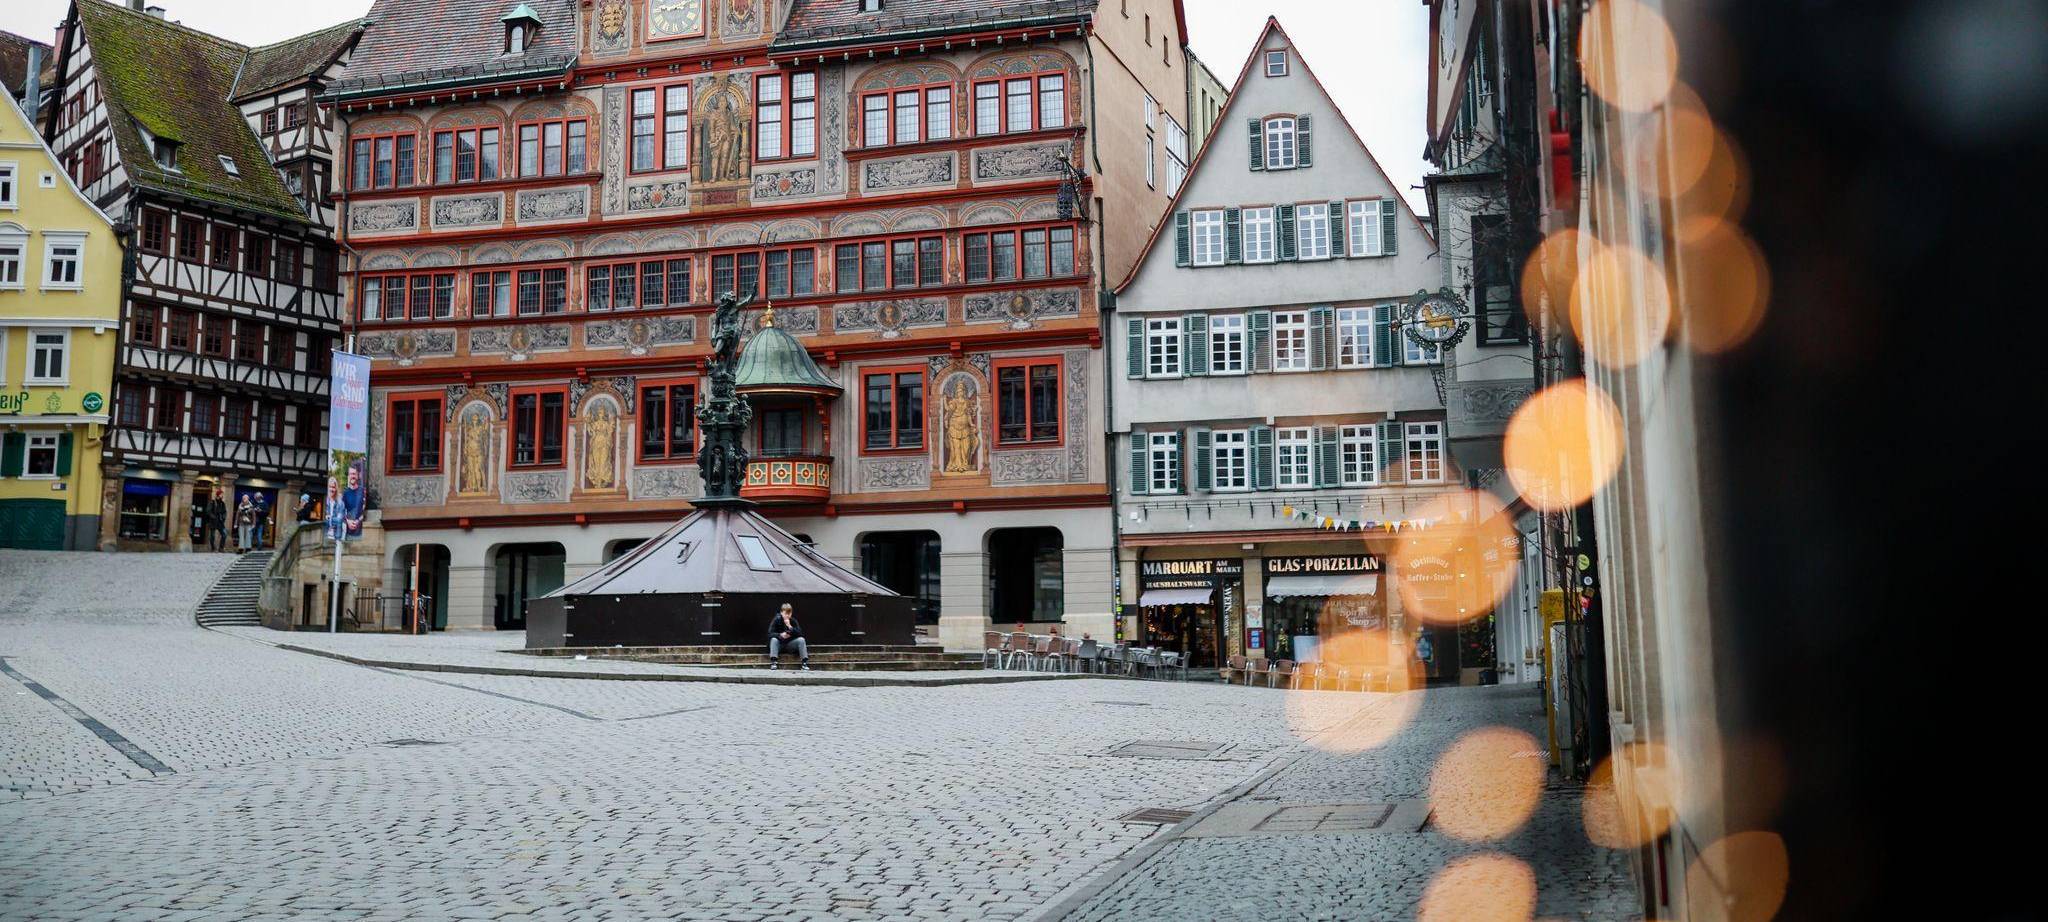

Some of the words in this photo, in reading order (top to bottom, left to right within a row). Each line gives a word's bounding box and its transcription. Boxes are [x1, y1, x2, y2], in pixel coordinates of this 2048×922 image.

[335, 359, 357, 381] WIR
[341, 383, 365, 403] SIND
[1143, 561, 1213, 575] MARQUART
[1268, 557, 1379, 572] GLAS-PORZELLAN
[1146, 580, 1213, 589] HAUSHALTSWAREN
[1223, 587, 1232, 612] WEIN
